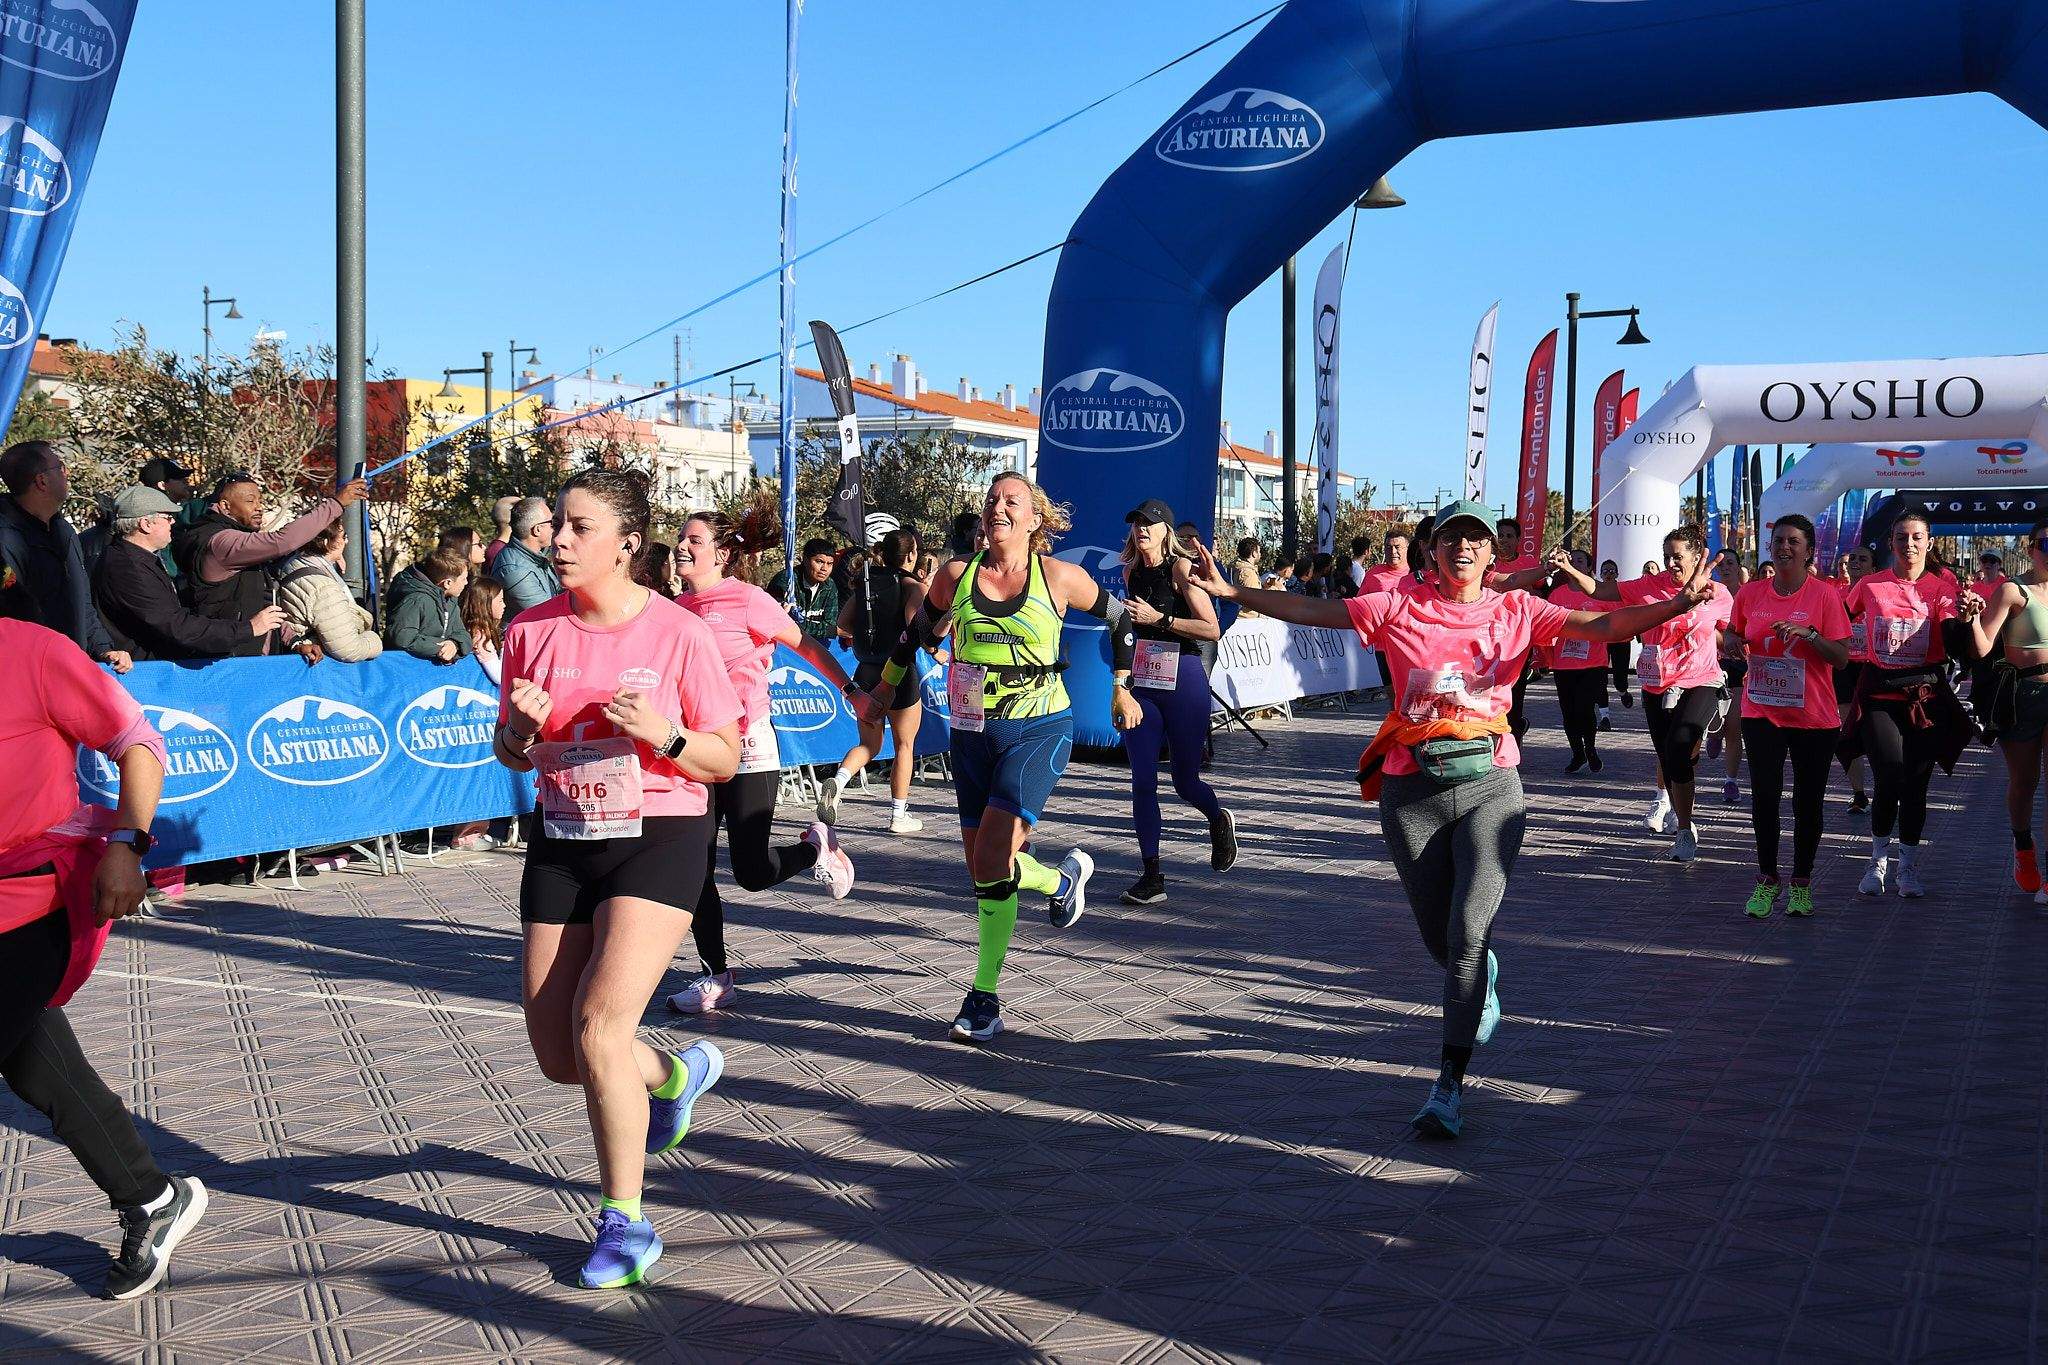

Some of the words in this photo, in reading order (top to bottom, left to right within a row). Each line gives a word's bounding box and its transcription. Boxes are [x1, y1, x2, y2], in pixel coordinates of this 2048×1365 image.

[1192, 115, 1243, 128] CENTRAL
[1248, 114, 1306, 123] LECHERA
[1163, 125, 1311, 154] ASTURIANA
[1061, 397, 1108, 405] CENTRAL
[1113, 398, 1169, 409] LECHERA
[1759, 375, 1985, 423] OYSHO
[1045, 400, 1173, 434] ASTURIANA
[1633, 432, 1695, 445] OYSHO
[1976, 467, 2028, 476] TotalEnergies
[1923, 500, 2037, 512] VOLVO
[1603, 513, 1660, 527] OYSHO
[1293, 627, 1345, 660] OYSHO
[536, 666, 582, 679] OSHO
[1766, 677, 1787, 688] 016
[770, 697, 834, 716] STURIANA
[423, 714, 462, 724] CENTRAL
[277, 727, 322, 738] CENTRAL
[325, 722, 372, 734] LECHERA
[409, 719, 497, 752] ASTURIAN
[167, 734, 218, 747] LECHERA
[262, 731, 383, 767] ASTURIANA
[568, 782, 608, 800] 016
